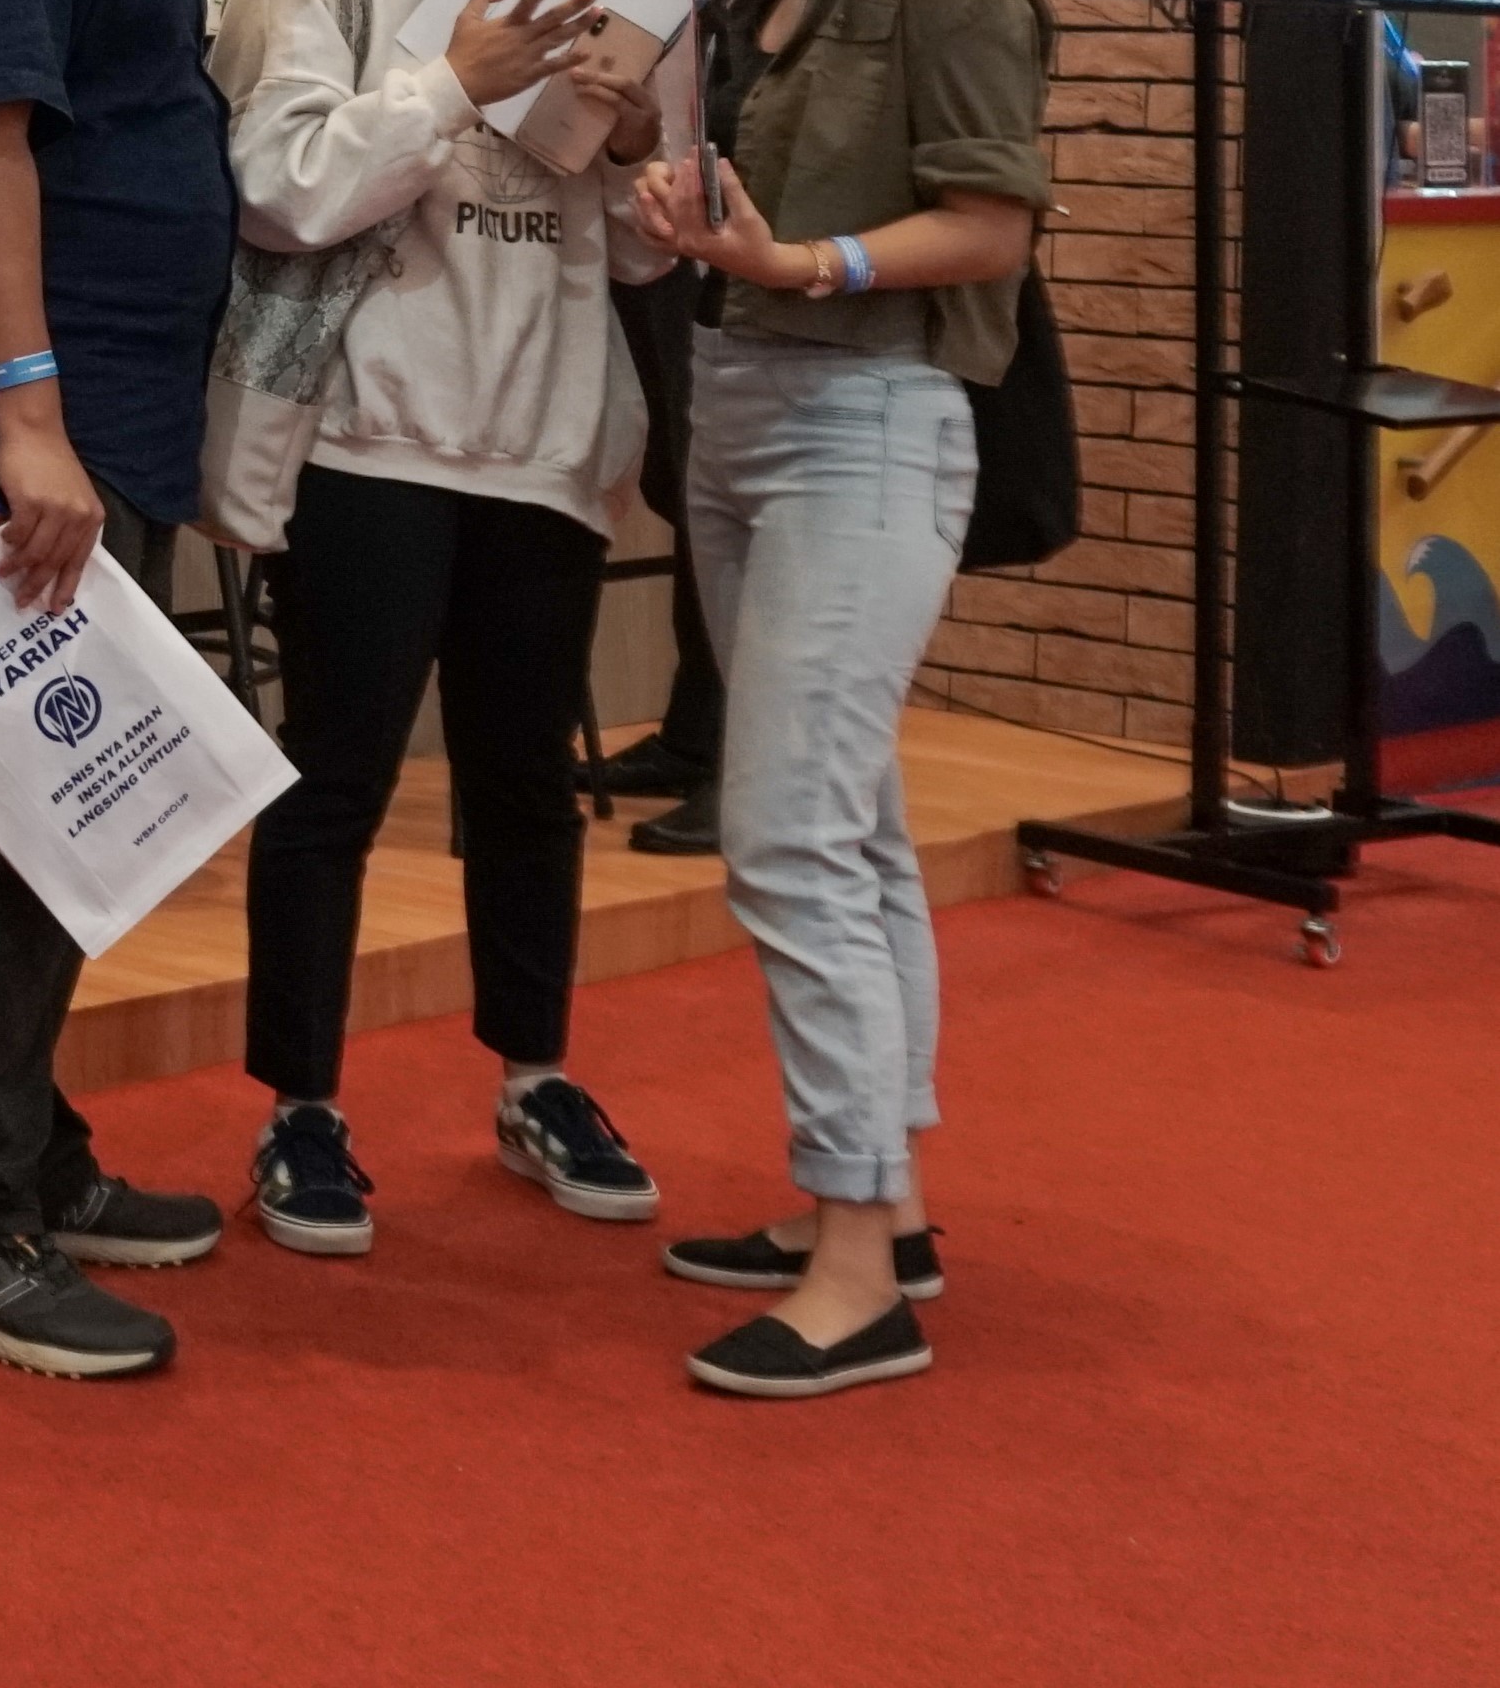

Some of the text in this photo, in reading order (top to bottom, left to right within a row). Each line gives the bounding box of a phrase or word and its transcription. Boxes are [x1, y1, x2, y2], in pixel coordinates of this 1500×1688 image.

[50, 705, 163, 805] BISNIS NYA AMAN
[67, 725, 191, 839] LANGSUNG UNTUNG
[77, 732, 159, 805] INSYA ALLAH
[132, 792, 190, 848] WBM GROUP
